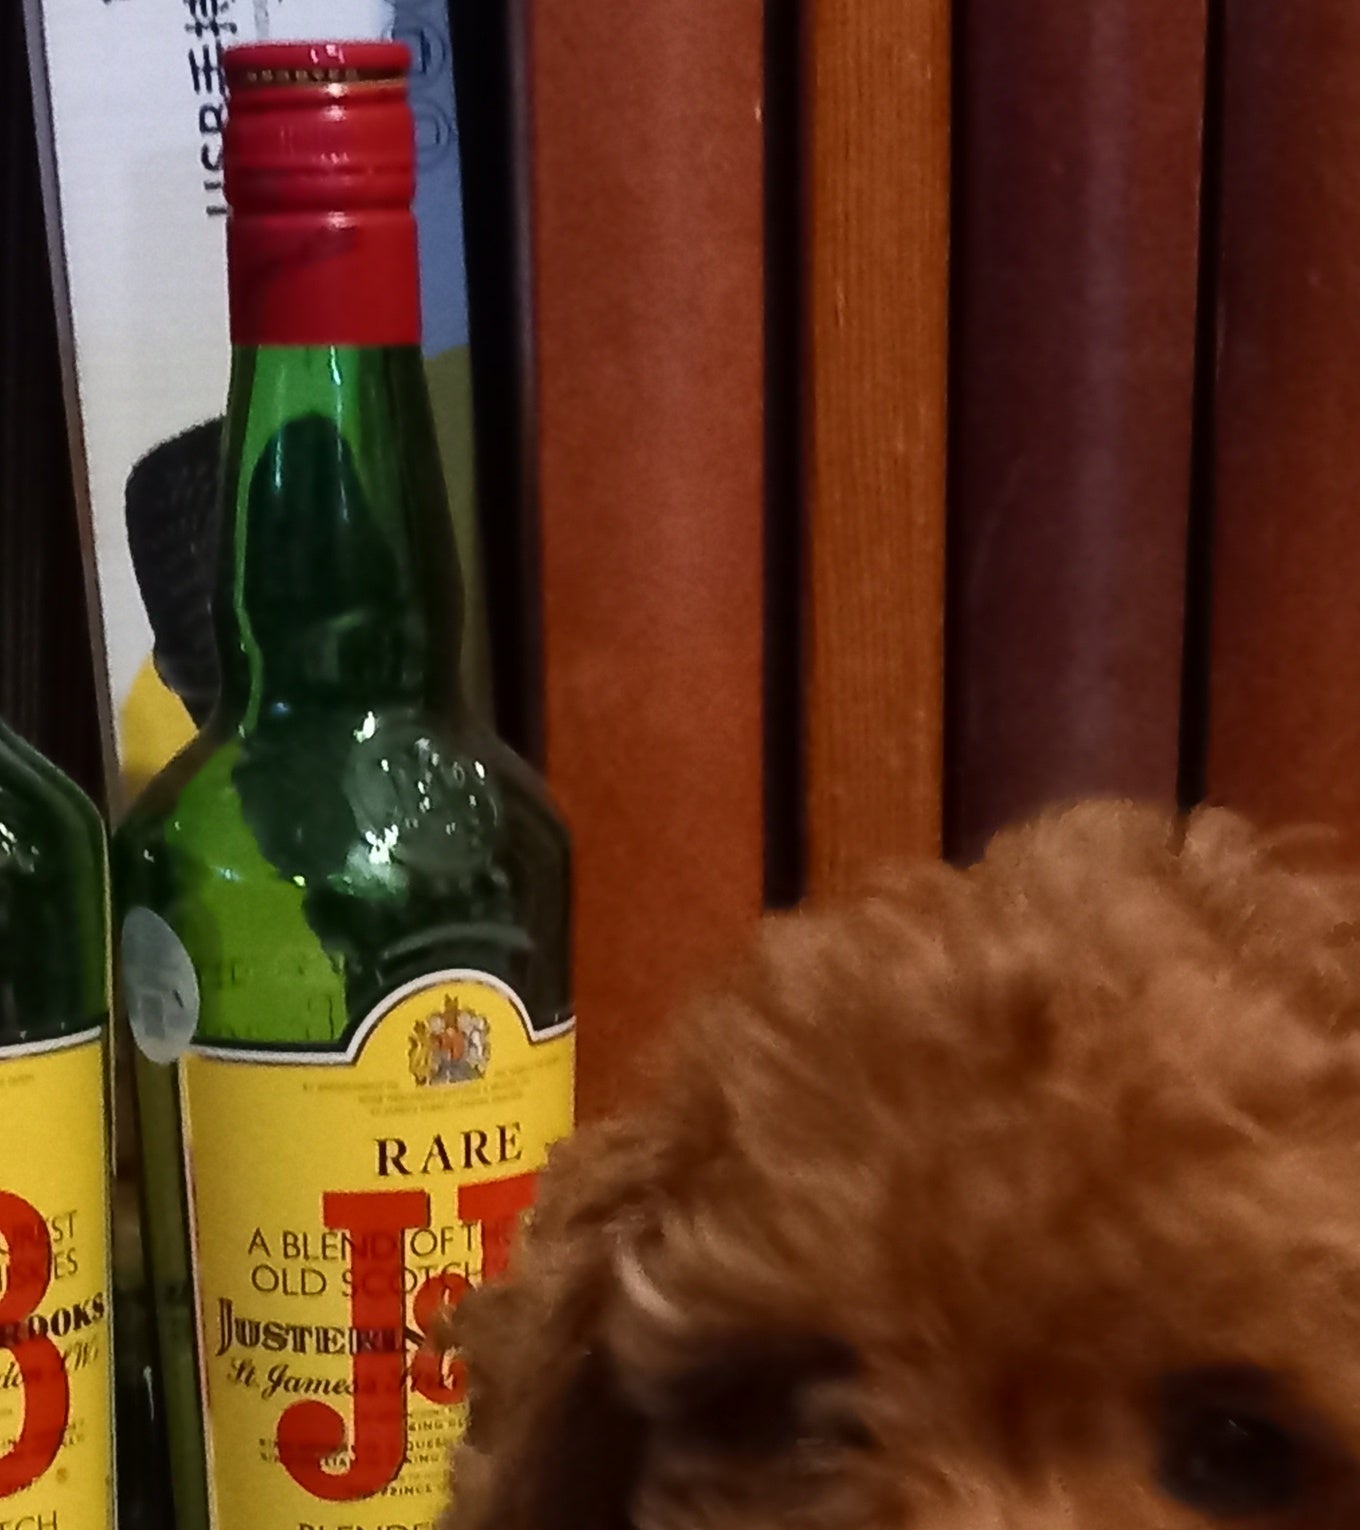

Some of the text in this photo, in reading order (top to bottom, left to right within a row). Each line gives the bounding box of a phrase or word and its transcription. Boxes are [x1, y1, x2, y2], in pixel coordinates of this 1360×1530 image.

[374, 1121, 524, 1177] RARE
[247, 1226, 272, 1257] A
[410, 1226, 455, 1257] OF
[250, 1263, 328, 1298] OLD
